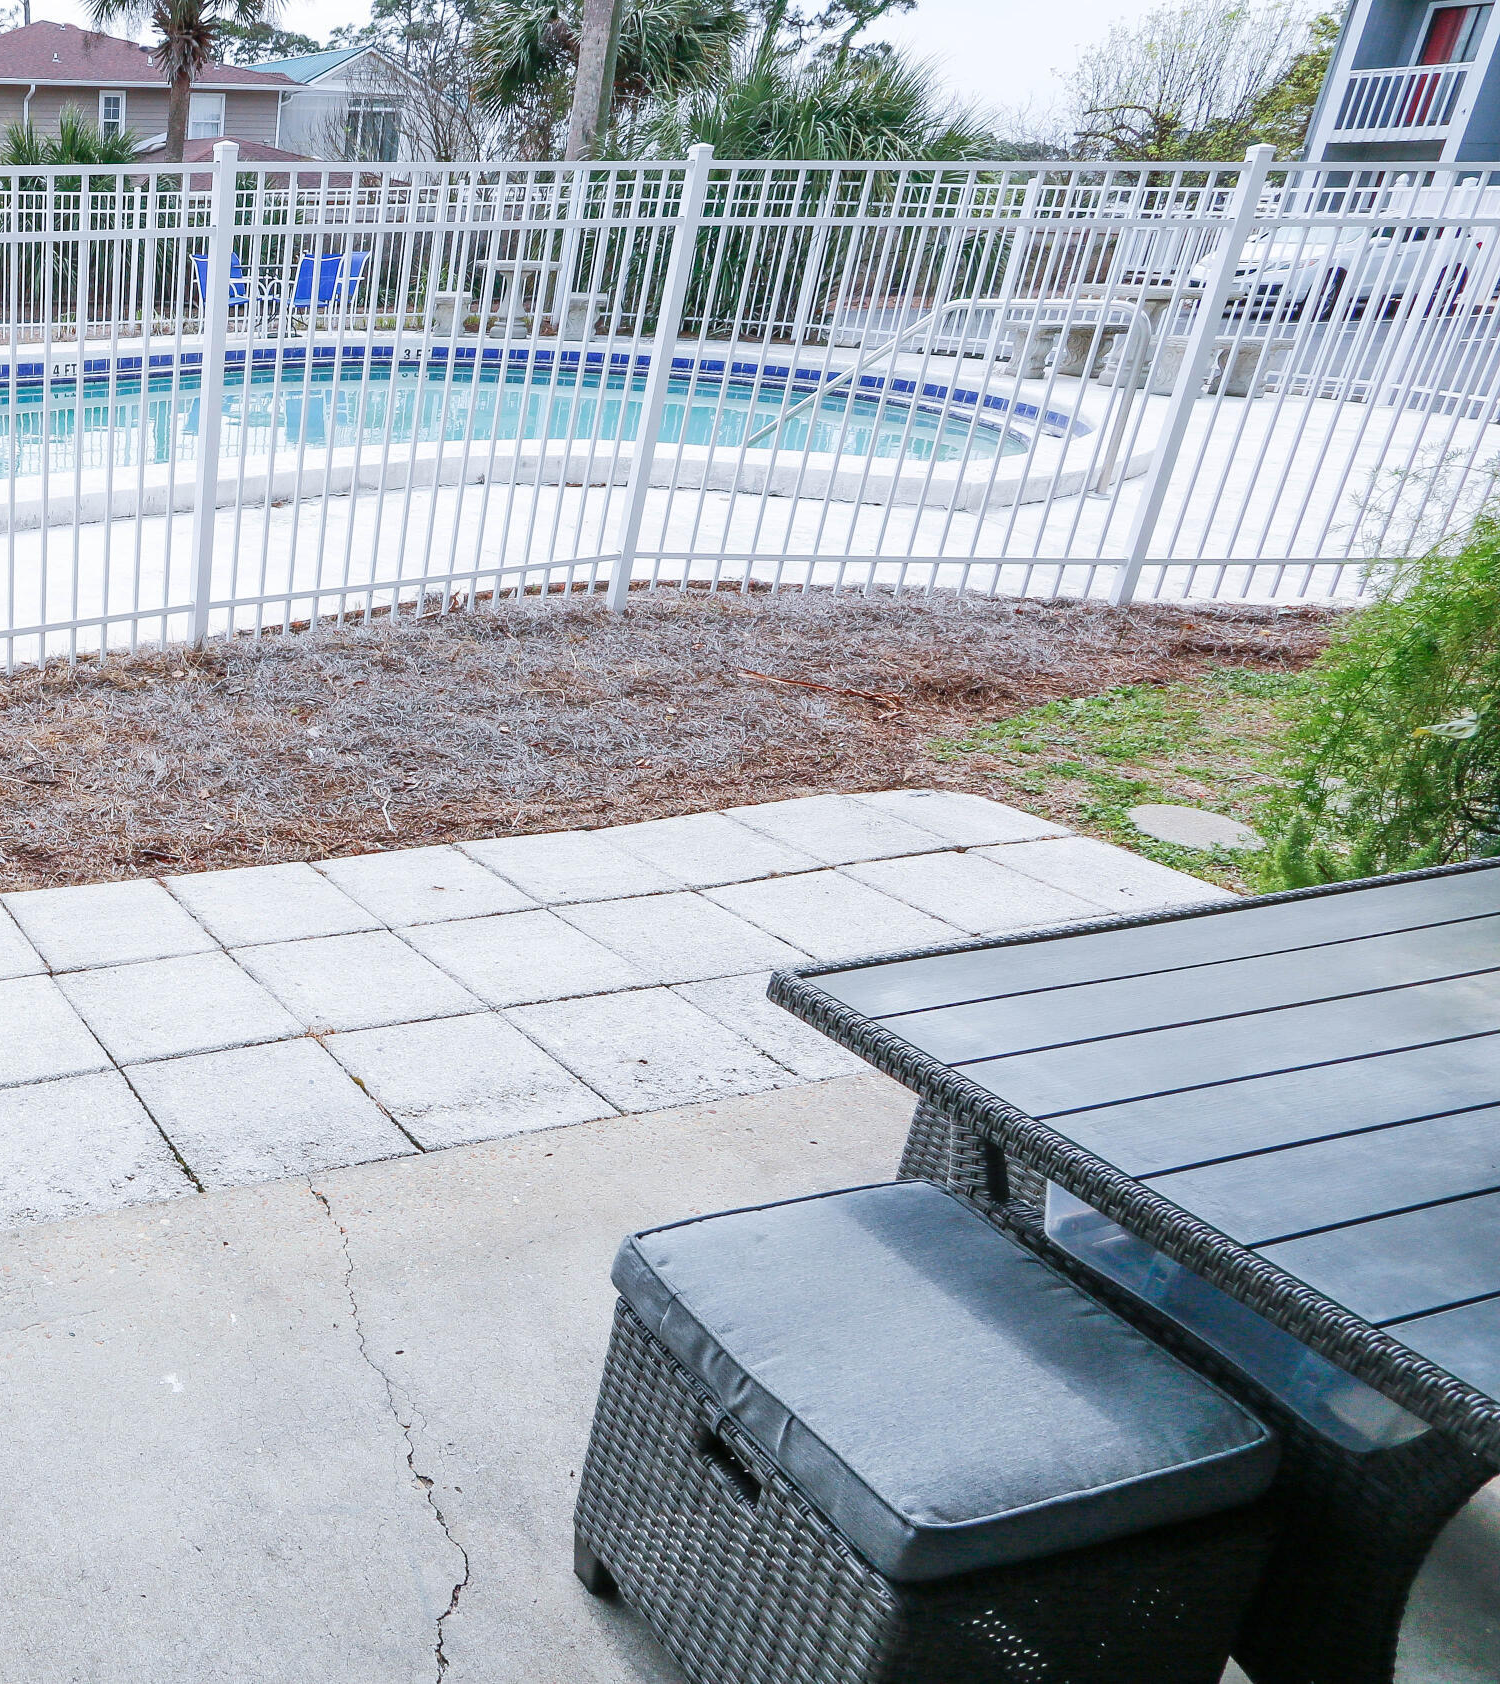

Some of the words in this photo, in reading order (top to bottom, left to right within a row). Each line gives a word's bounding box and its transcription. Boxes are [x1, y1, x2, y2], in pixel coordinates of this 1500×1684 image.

[404, 349, 411, 360] 3
[53, 364, 60, 377] 4
[65, 363, 77, 377] FT
